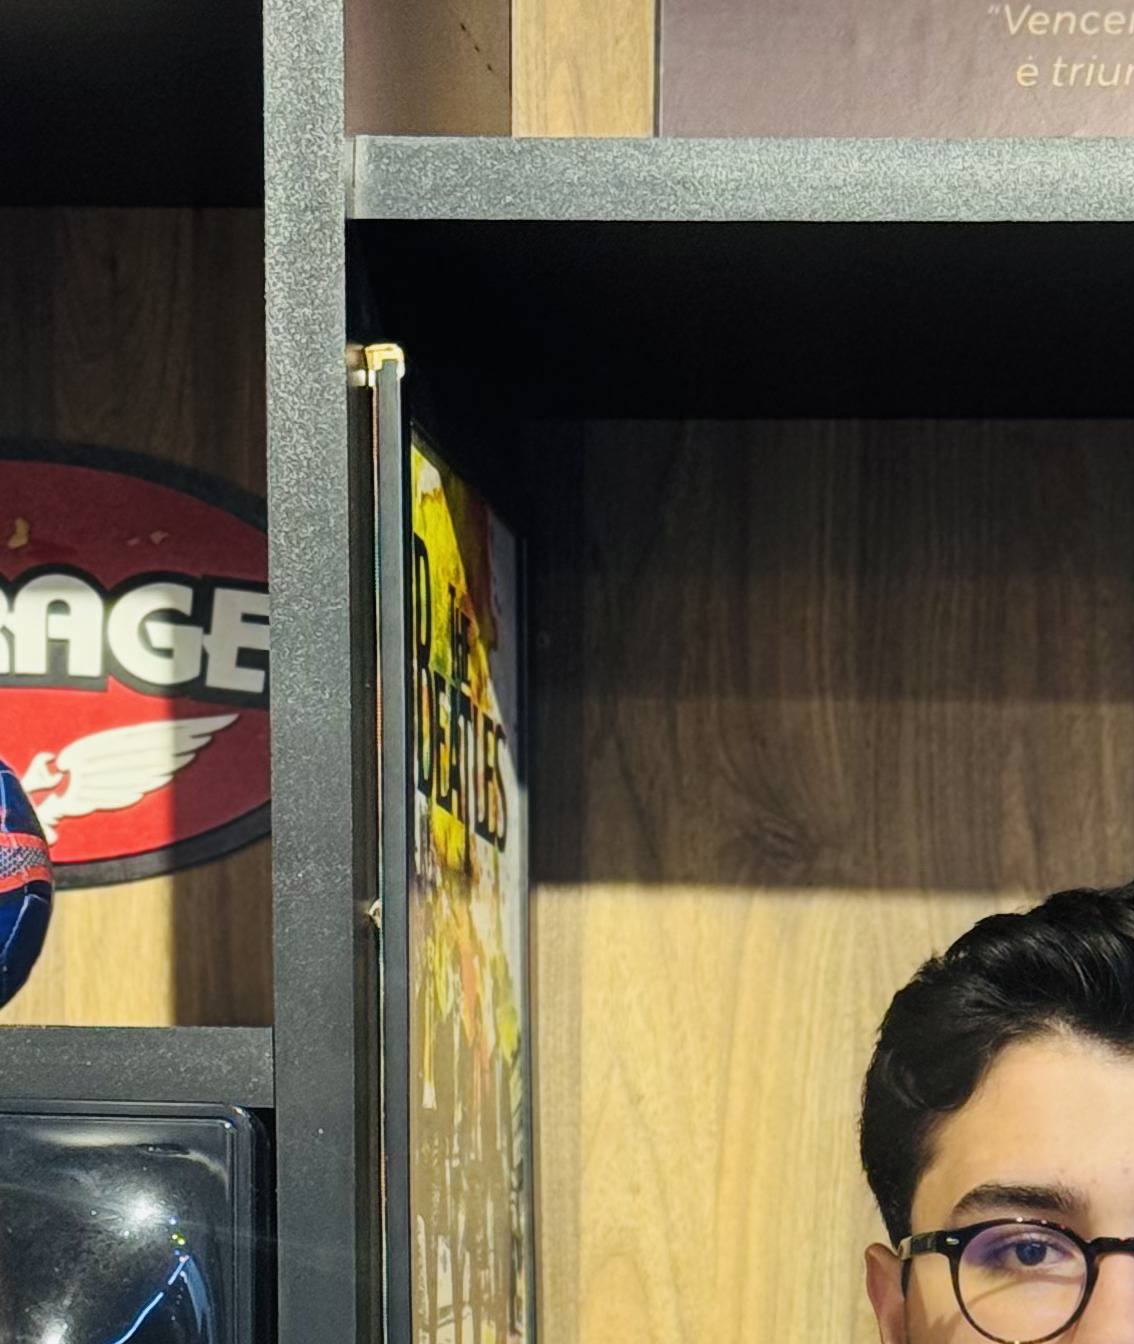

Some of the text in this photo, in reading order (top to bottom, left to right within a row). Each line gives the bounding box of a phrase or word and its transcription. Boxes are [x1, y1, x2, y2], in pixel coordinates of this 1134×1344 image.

[1015, 54, 1040, 87] é
[0, 573, 270, 694] AGE
[412, 533, 508, 854] BEATLES
